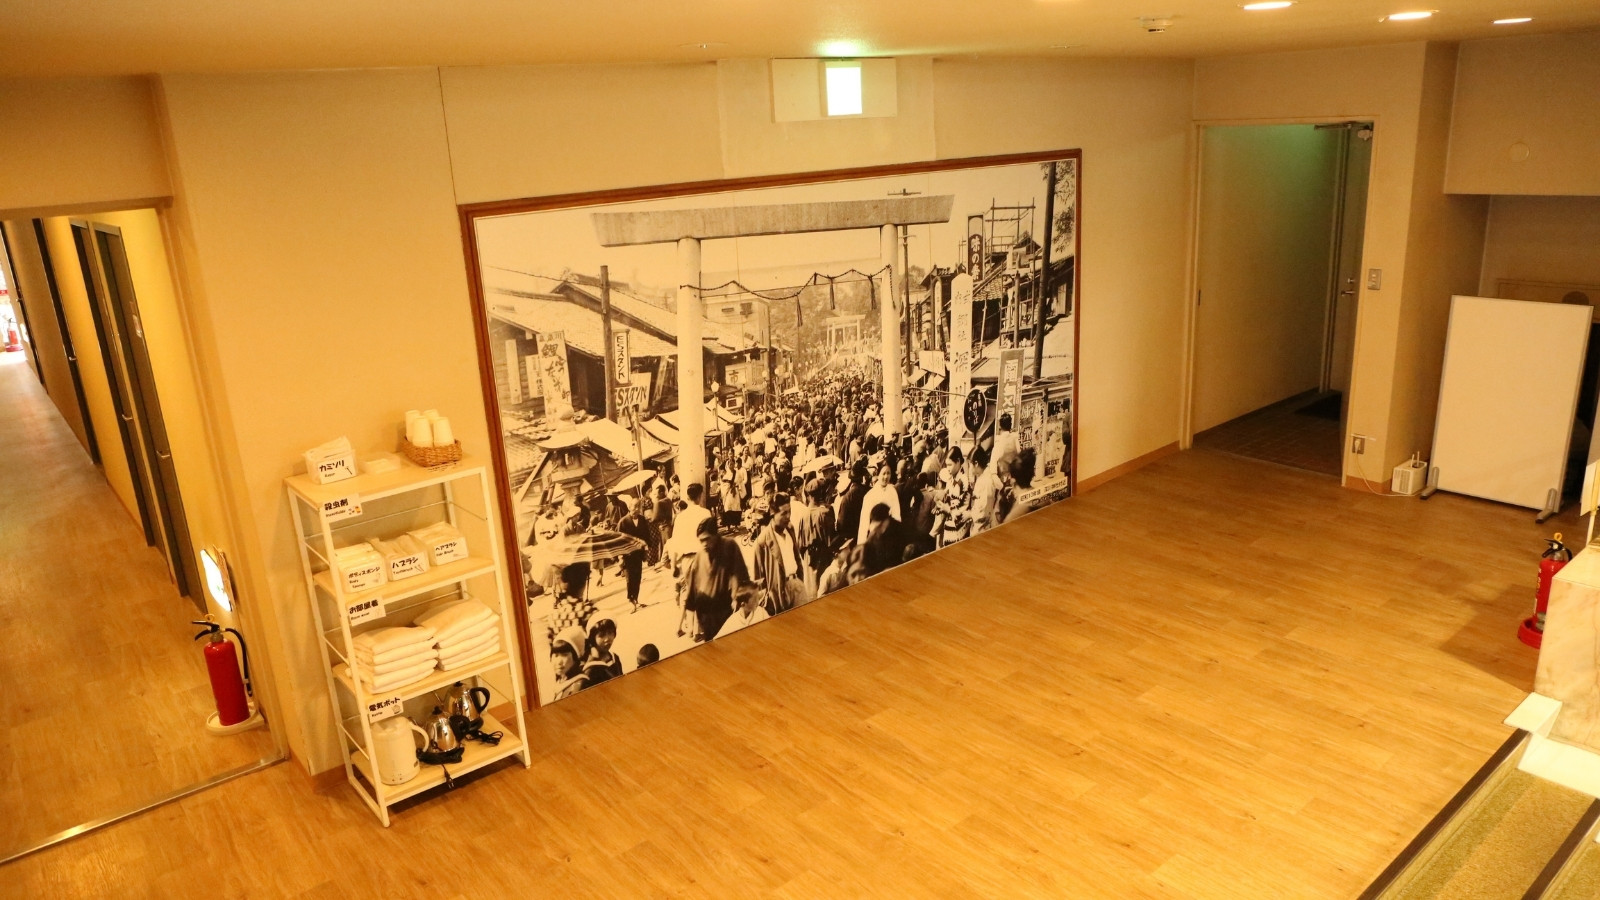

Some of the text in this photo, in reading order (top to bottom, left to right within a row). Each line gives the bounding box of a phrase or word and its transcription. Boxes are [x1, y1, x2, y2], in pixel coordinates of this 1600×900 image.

[615, 385, 648, 407] Sスタンド
[319, 459, 345, 472] カミソリ
[324, 498, 349, 511] 殺虫剤
[435, 541, 458, 551] ヘアブラシ
[391, 556, 419, 569] ハブラシ
[348, 566, 381, 579] ボディスポンジ
[348, 599, 379, 615] お部屋着
[368, 697, 401, 712] 電気ポット
